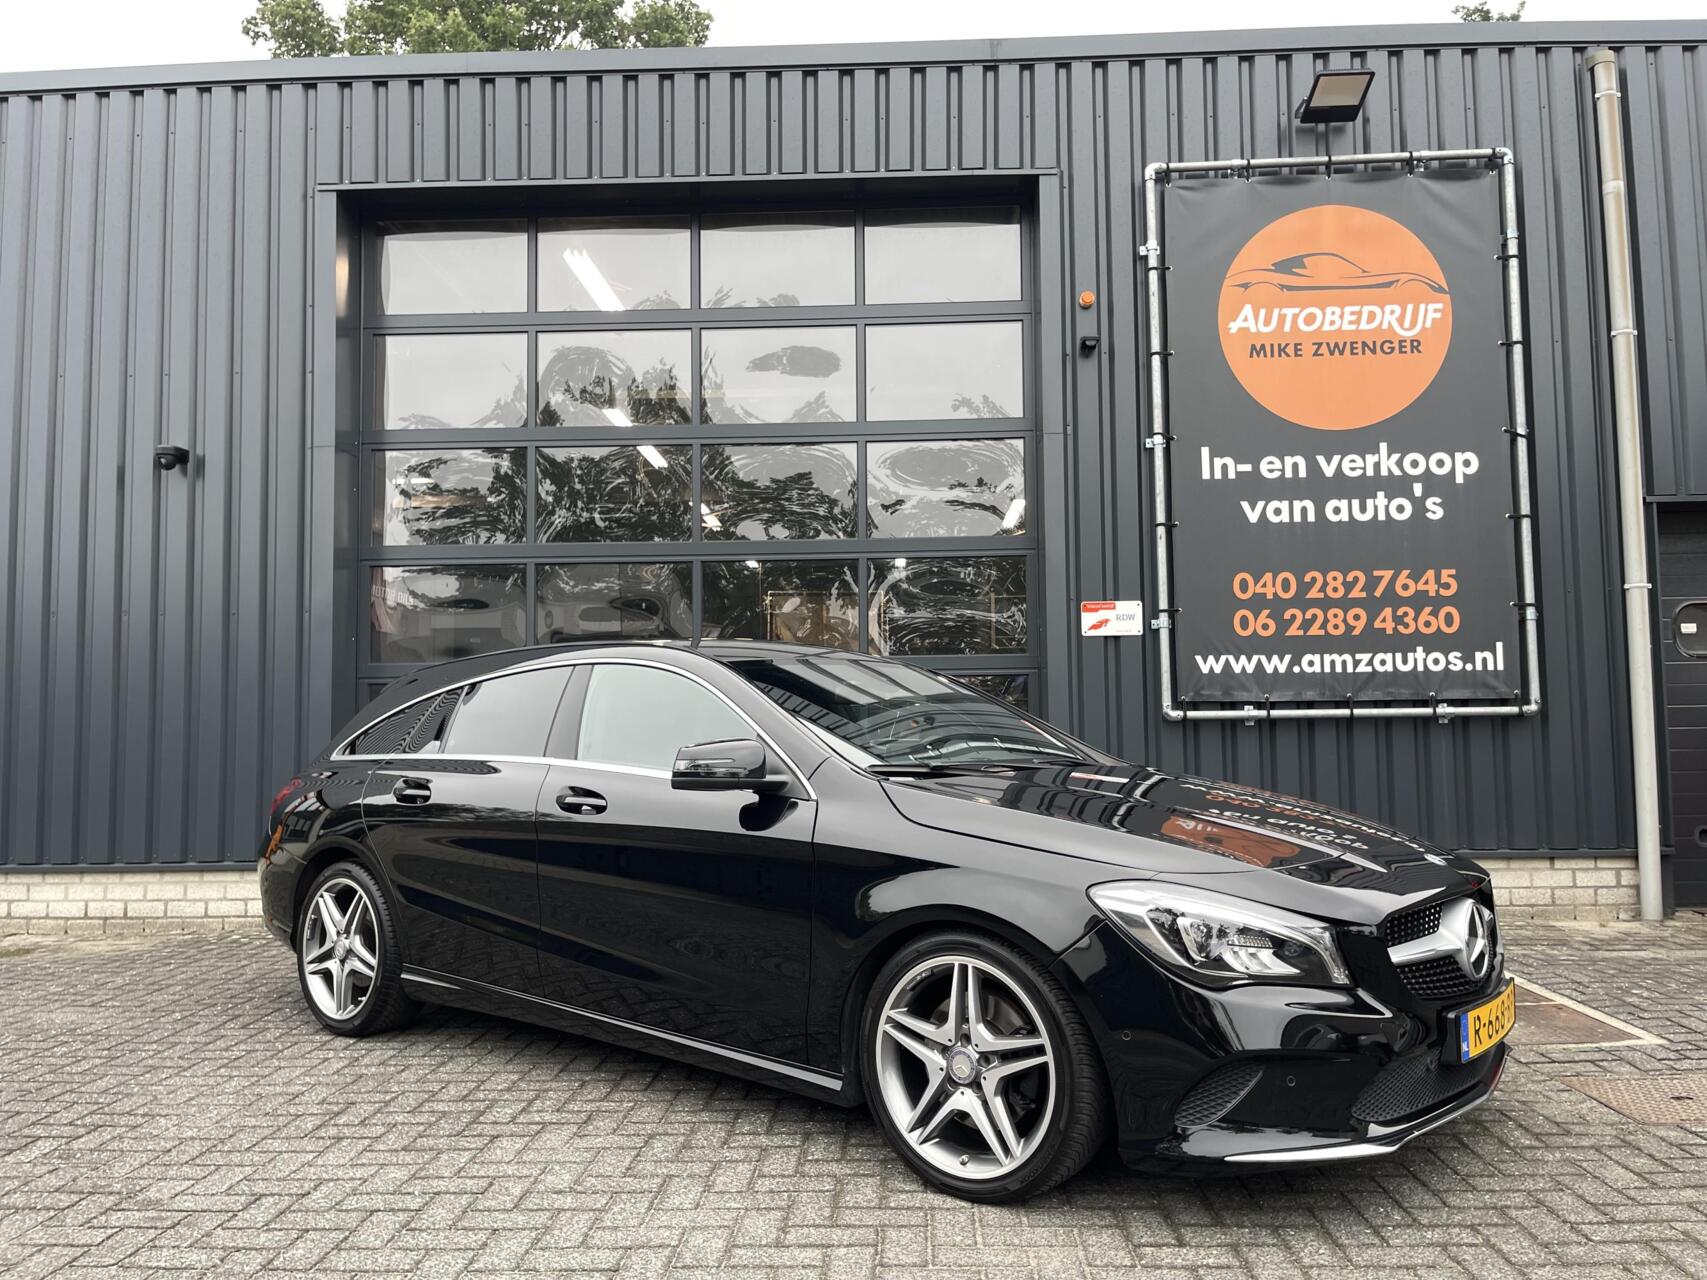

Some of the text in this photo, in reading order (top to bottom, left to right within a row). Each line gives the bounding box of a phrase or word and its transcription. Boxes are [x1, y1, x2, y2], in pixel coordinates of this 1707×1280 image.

[1228, 302, 1443, 337] AUTOBEDRIJF
[1249, 339, 1422, 359] MIKE ZWENGER
[1259, 454, 1307, 480] en
[1316, 442, 1480, 484] verkoop
[1240, 482, 1444, 524] van auto's
[1232, 569, 1457, 600] 040 282 7645
[1115, 613, 1136, 622] RDW
[1232, 606, 1461, 638] 06 2289 4360
[1194, 641, 1505, 674] www.amzautos.nl
